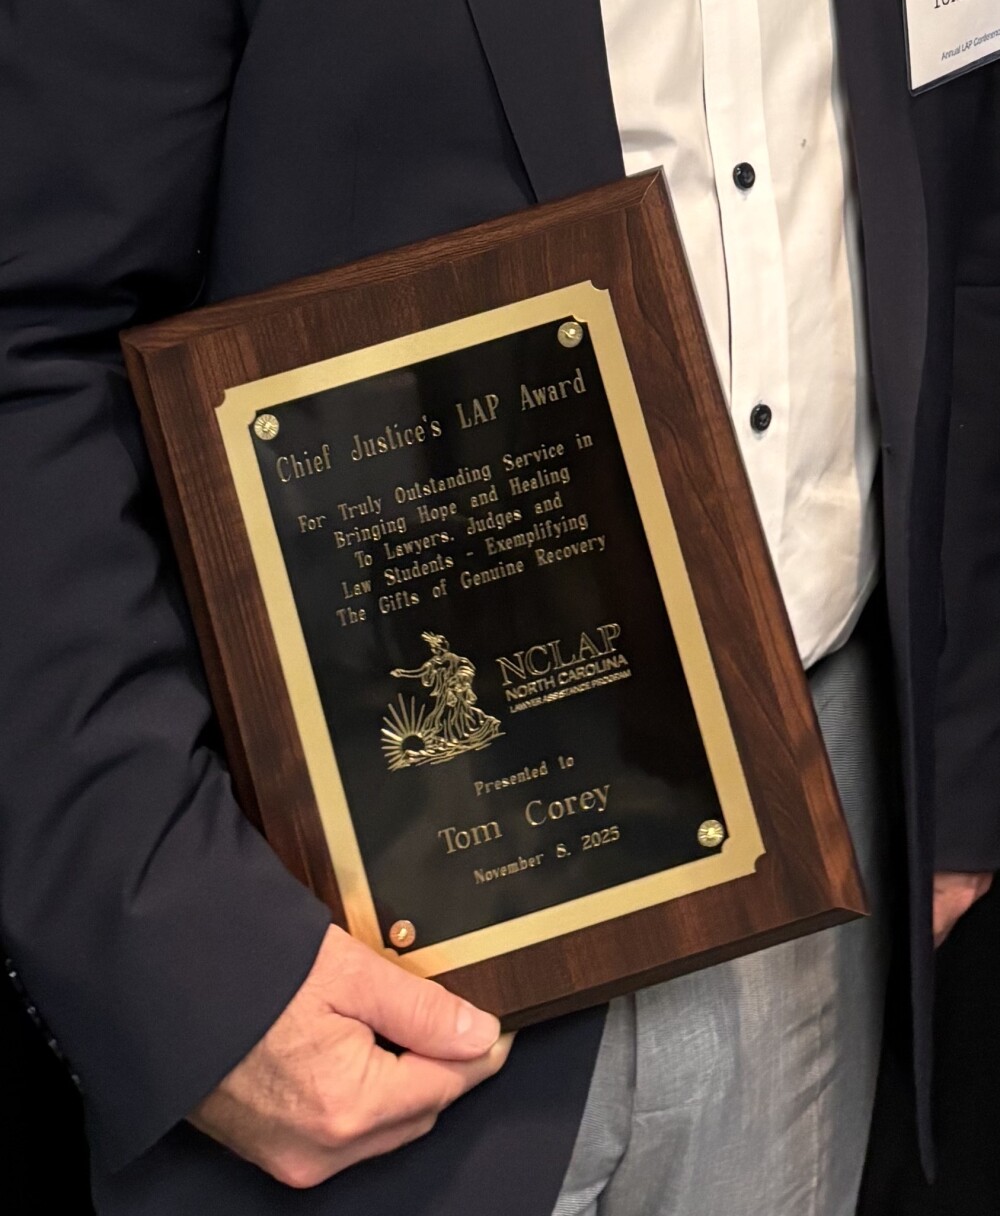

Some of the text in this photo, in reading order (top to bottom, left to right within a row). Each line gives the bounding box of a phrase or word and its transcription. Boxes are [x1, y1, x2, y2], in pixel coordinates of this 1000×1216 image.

[941, 44, 960, 61] Annual
[961, 40, 973, 52] LAP
[276, 368, 586, 482] Chief Justice's LAP Award
[298, 433, 594, 533] For Truly Outstanding Service in
[333, 466, 571, 549] Bringing Hope and Healing
[341, 580, 372, 599] Law
[384, 555, 454, 587] Students
[485, 512, 589, 556] Exemplifying
[354, 549, 373, 568] To
[466, 507, 522, 535] Judges
[534, 491, 563, 514] and
[336, 534, 606, 627] The Gifts of Genuine Recovery
[496, 623, 621, 686] NCLAP
[505, 654, 629, 702] NORTH CAROLINA
[474, 755, 575, 797] Presented to
[437, 784, 610, 854] Tom Corey
[473, 853, 544, 884] November
[581, 825, 621, 851] 2025
